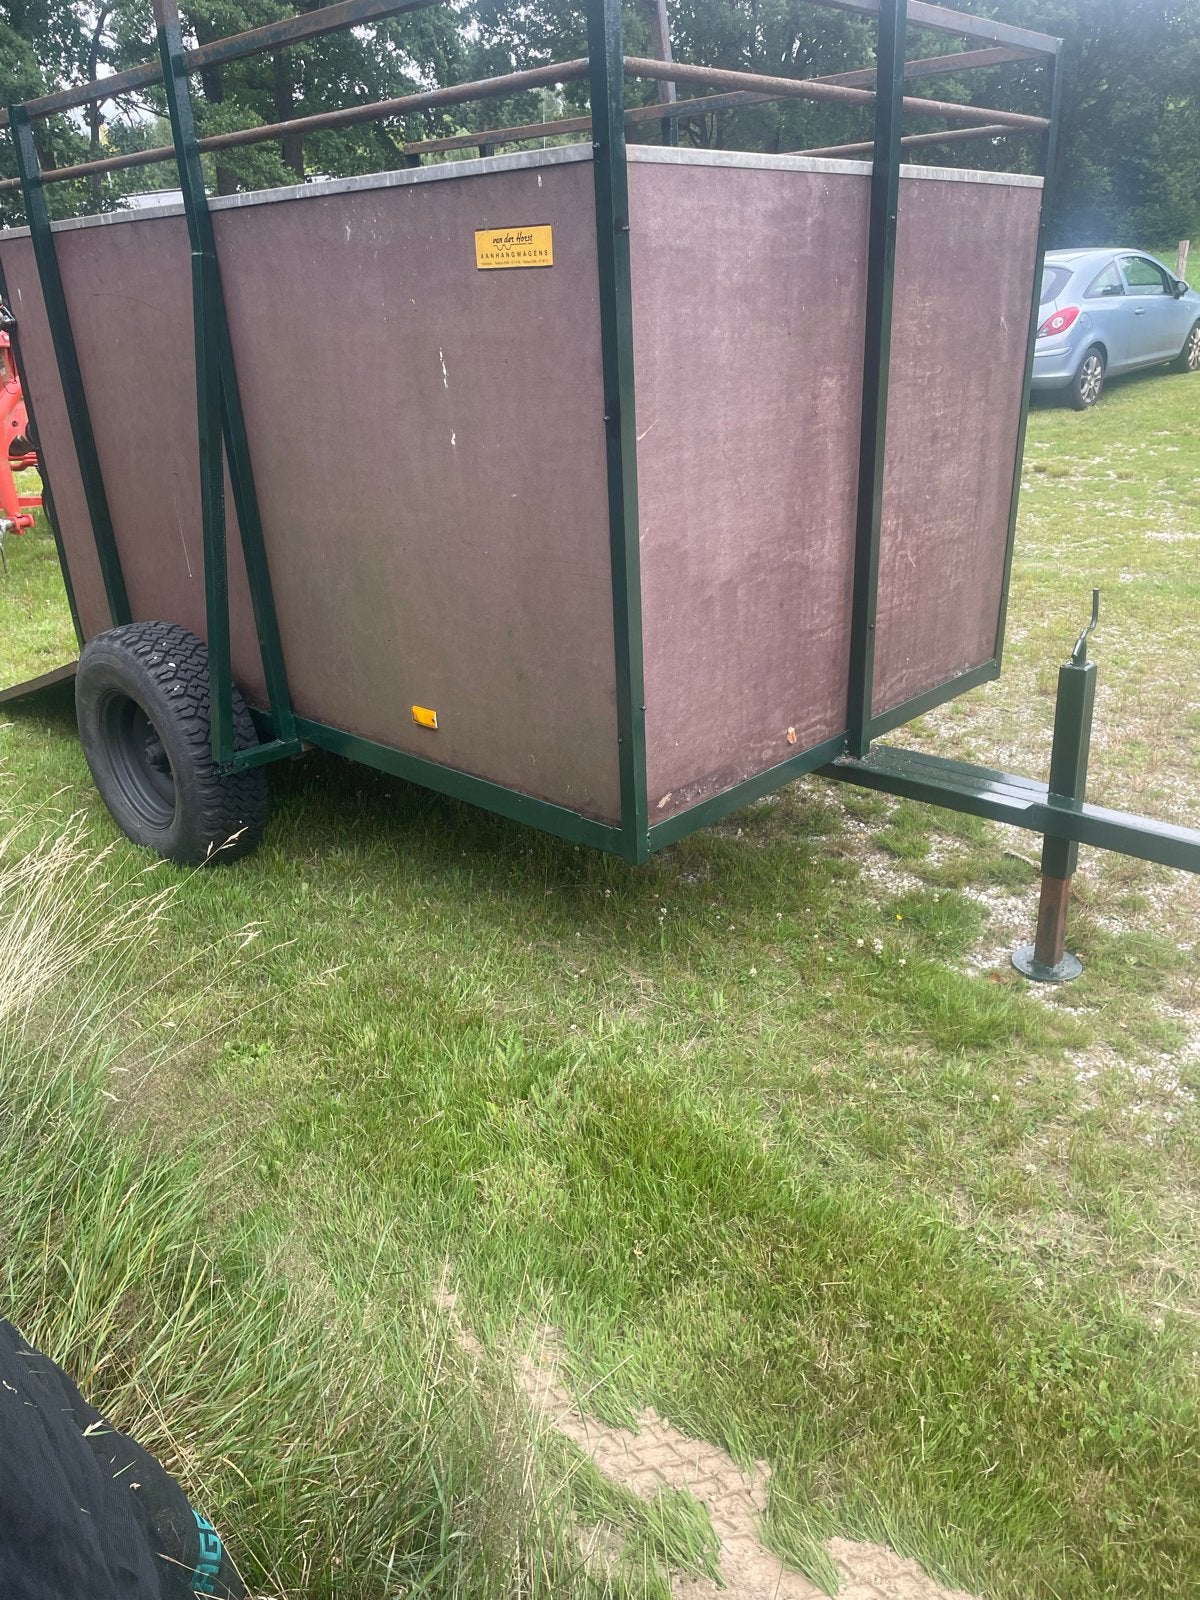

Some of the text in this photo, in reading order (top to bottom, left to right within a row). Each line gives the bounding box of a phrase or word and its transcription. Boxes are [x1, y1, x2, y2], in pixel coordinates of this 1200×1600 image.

[503, 232, 515, 243] der
[516, 231, 533, 243] Horst
[480, 250, 548, 259] AANHANGWAGENS
